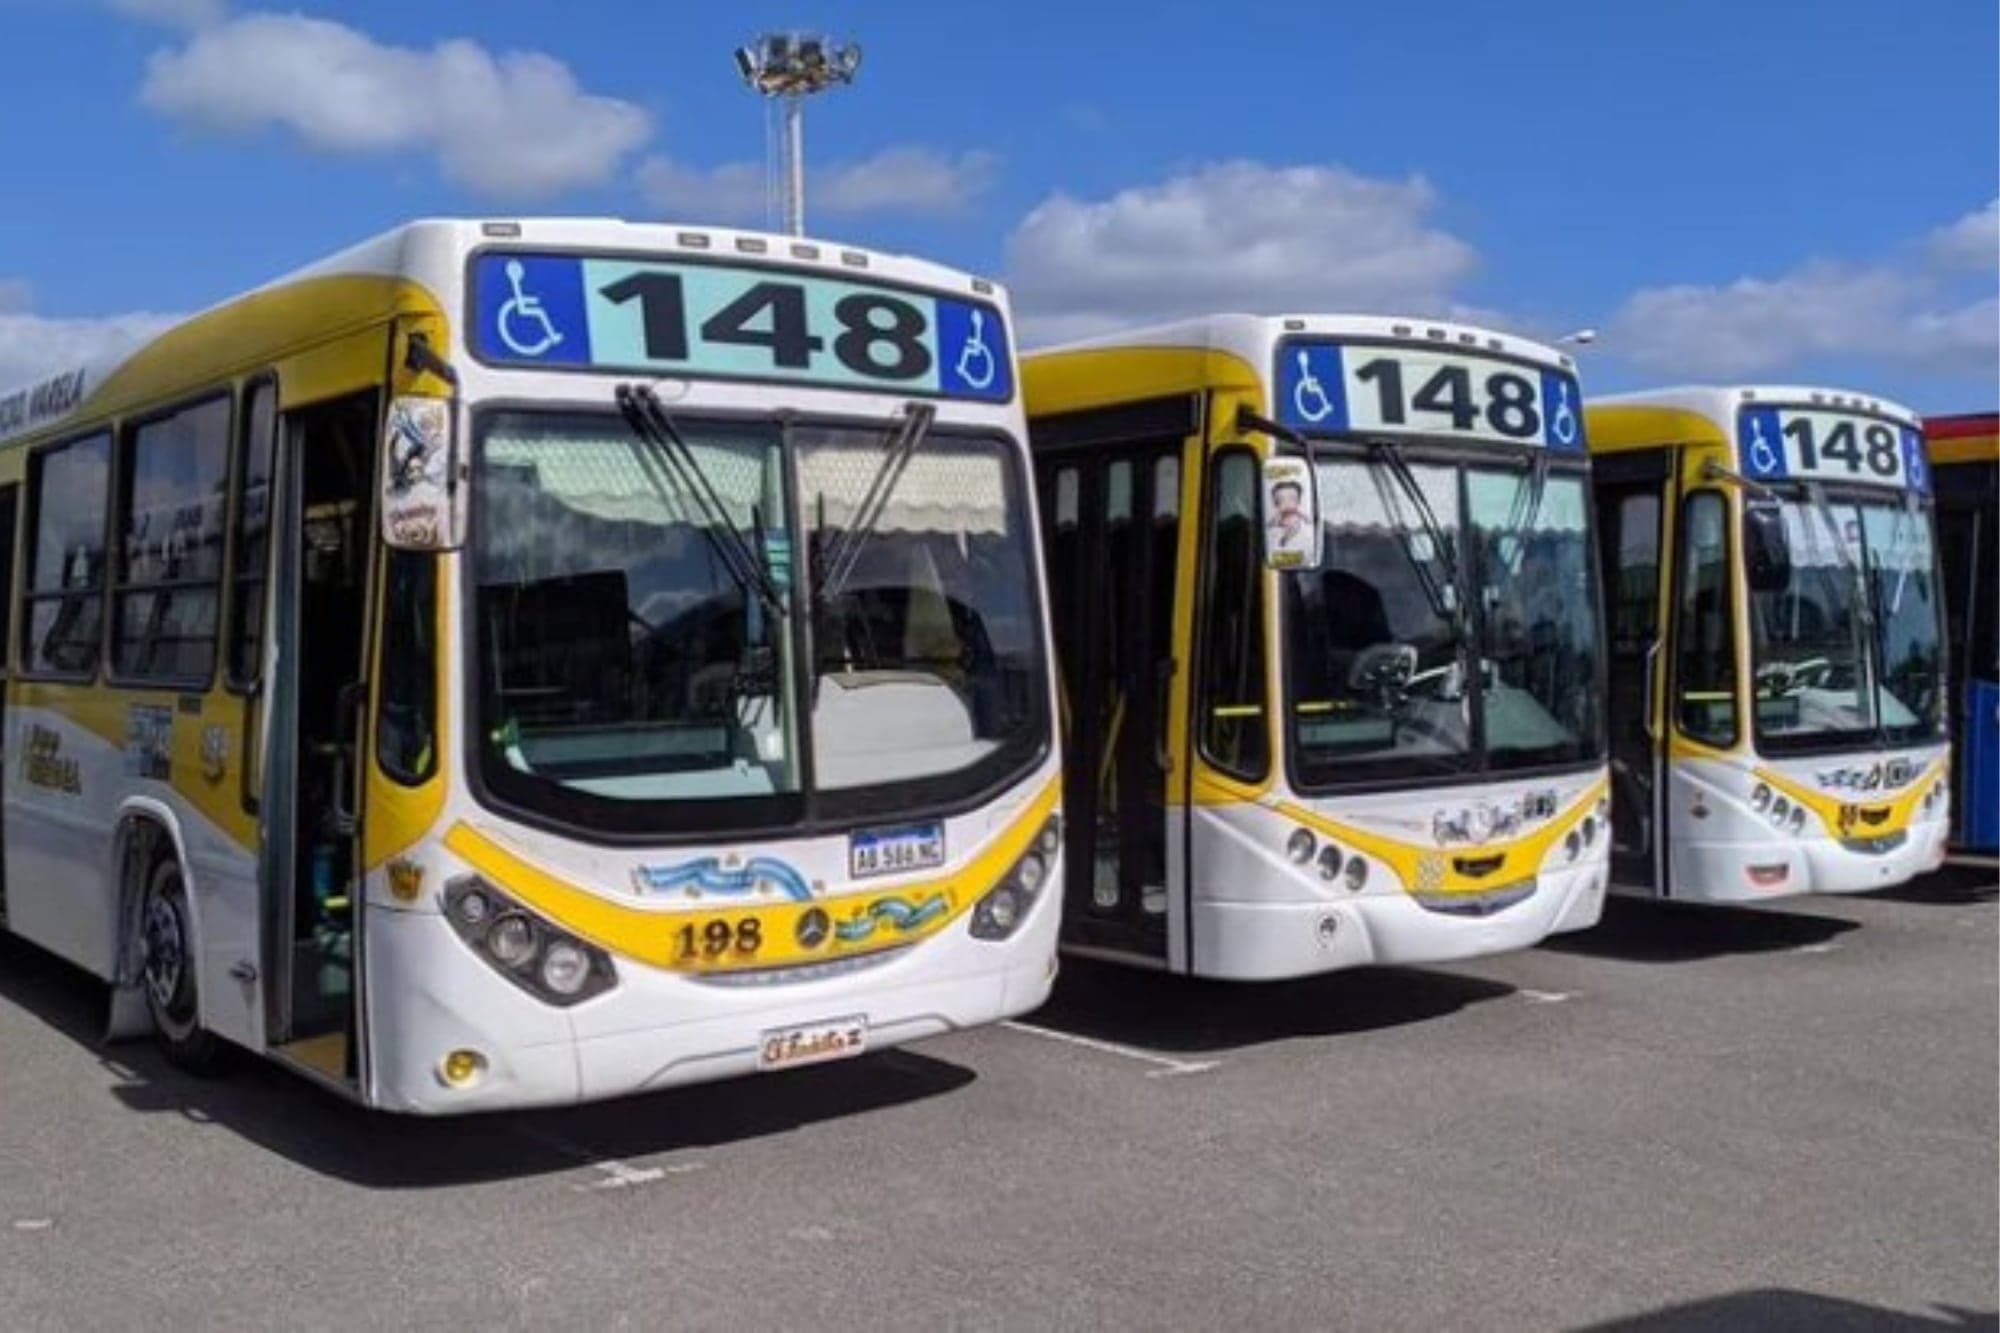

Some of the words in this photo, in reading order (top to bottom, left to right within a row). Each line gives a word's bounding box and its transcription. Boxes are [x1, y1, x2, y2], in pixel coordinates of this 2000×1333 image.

[597, 270, 933, 380] 148
[1355, 358, 1541, 438] 148
[1782, 416, 1899, 478] 148
[676, 917, 763, 962] 198
